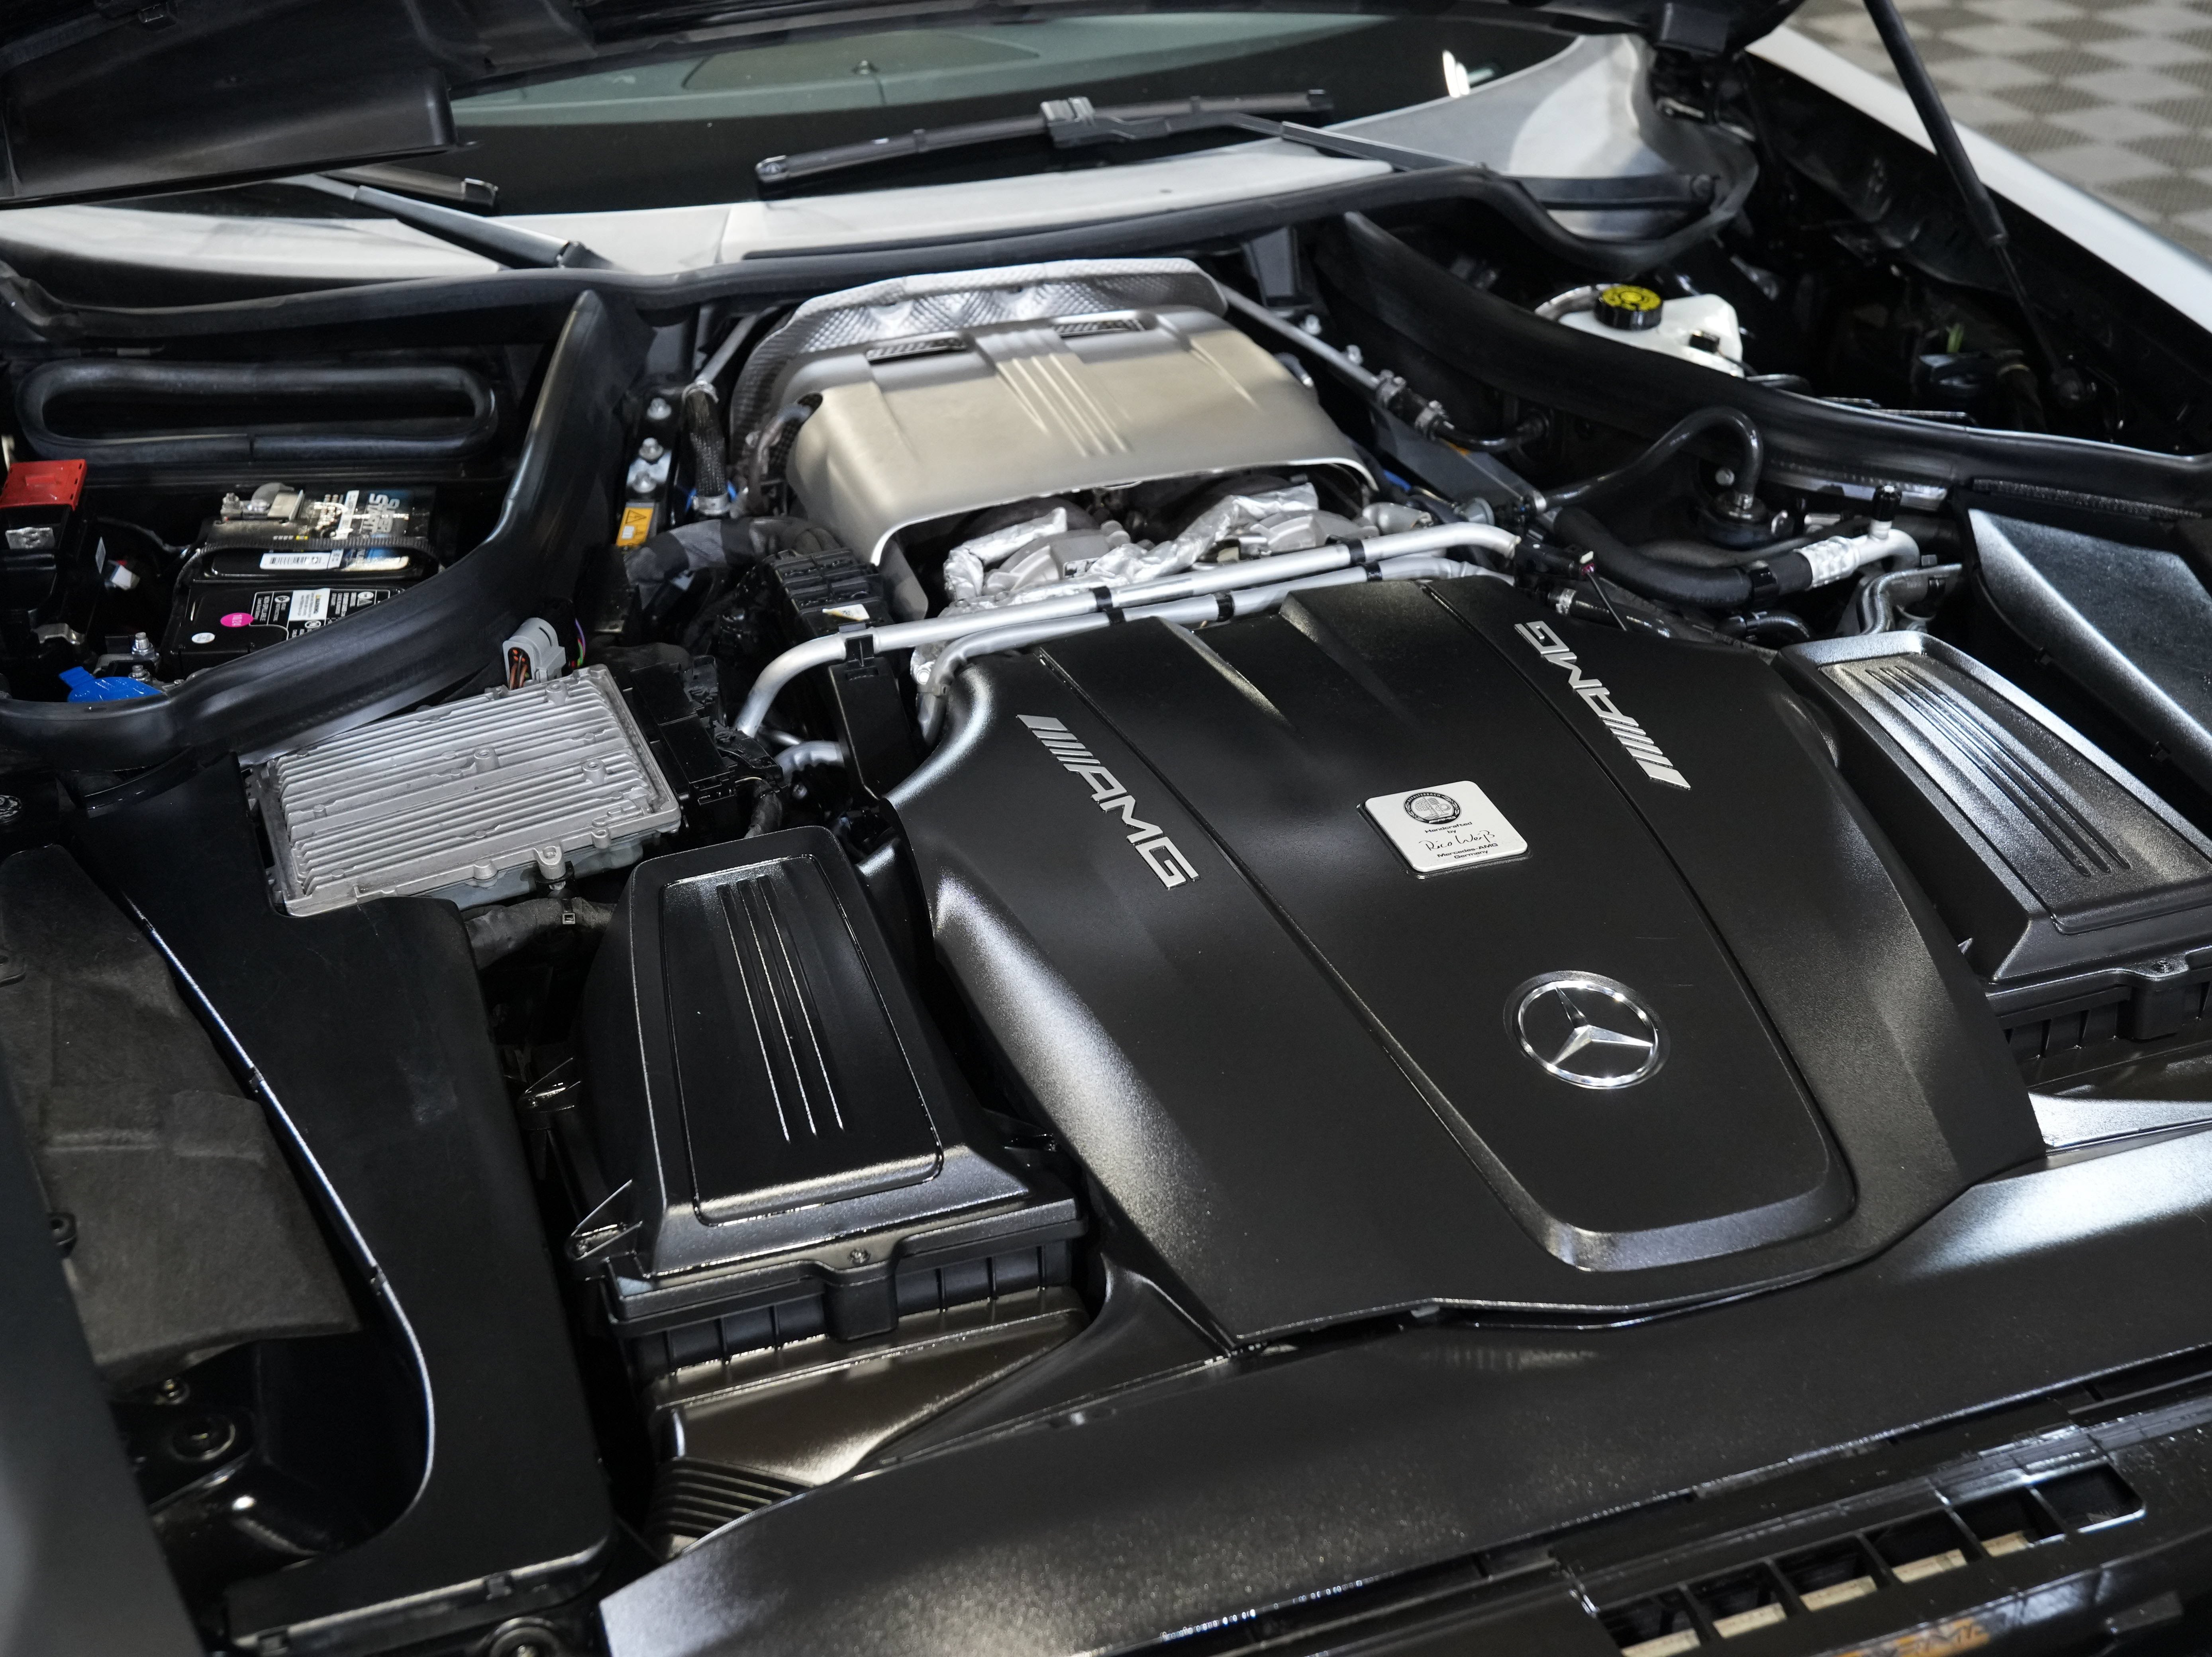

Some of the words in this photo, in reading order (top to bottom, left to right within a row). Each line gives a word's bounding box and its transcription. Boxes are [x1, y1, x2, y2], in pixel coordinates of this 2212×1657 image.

[1407, 792, 1441, 803] AFFALTERBACH
[1063, 763, 1200, 889] AMG
[1425, 821, 1473, 833] Handcrafted
[1437, 843, 1498, 857] Mercedes-AMG
[1454, 850, 1488, 859] Germany
